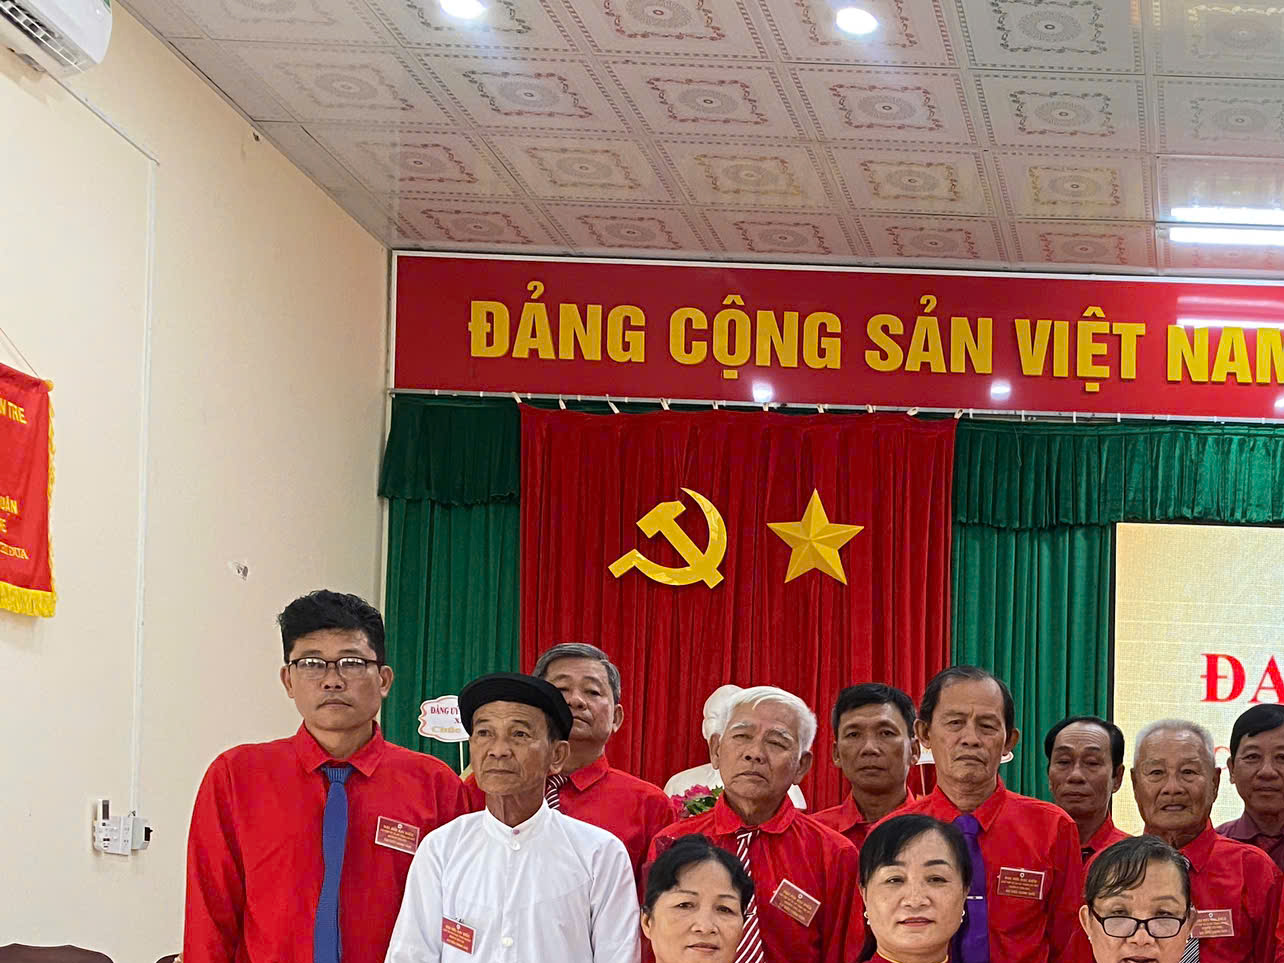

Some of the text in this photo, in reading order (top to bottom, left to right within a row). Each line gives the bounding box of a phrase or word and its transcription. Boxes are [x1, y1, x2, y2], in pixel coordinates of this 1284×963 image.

[468, 281, 646, 363] ĐẢNG
[670, 295, 841, 380] CỘNG
[866, 295, 994, 374] SẢN
[1015, 306, 1146, 392] VIỆT
